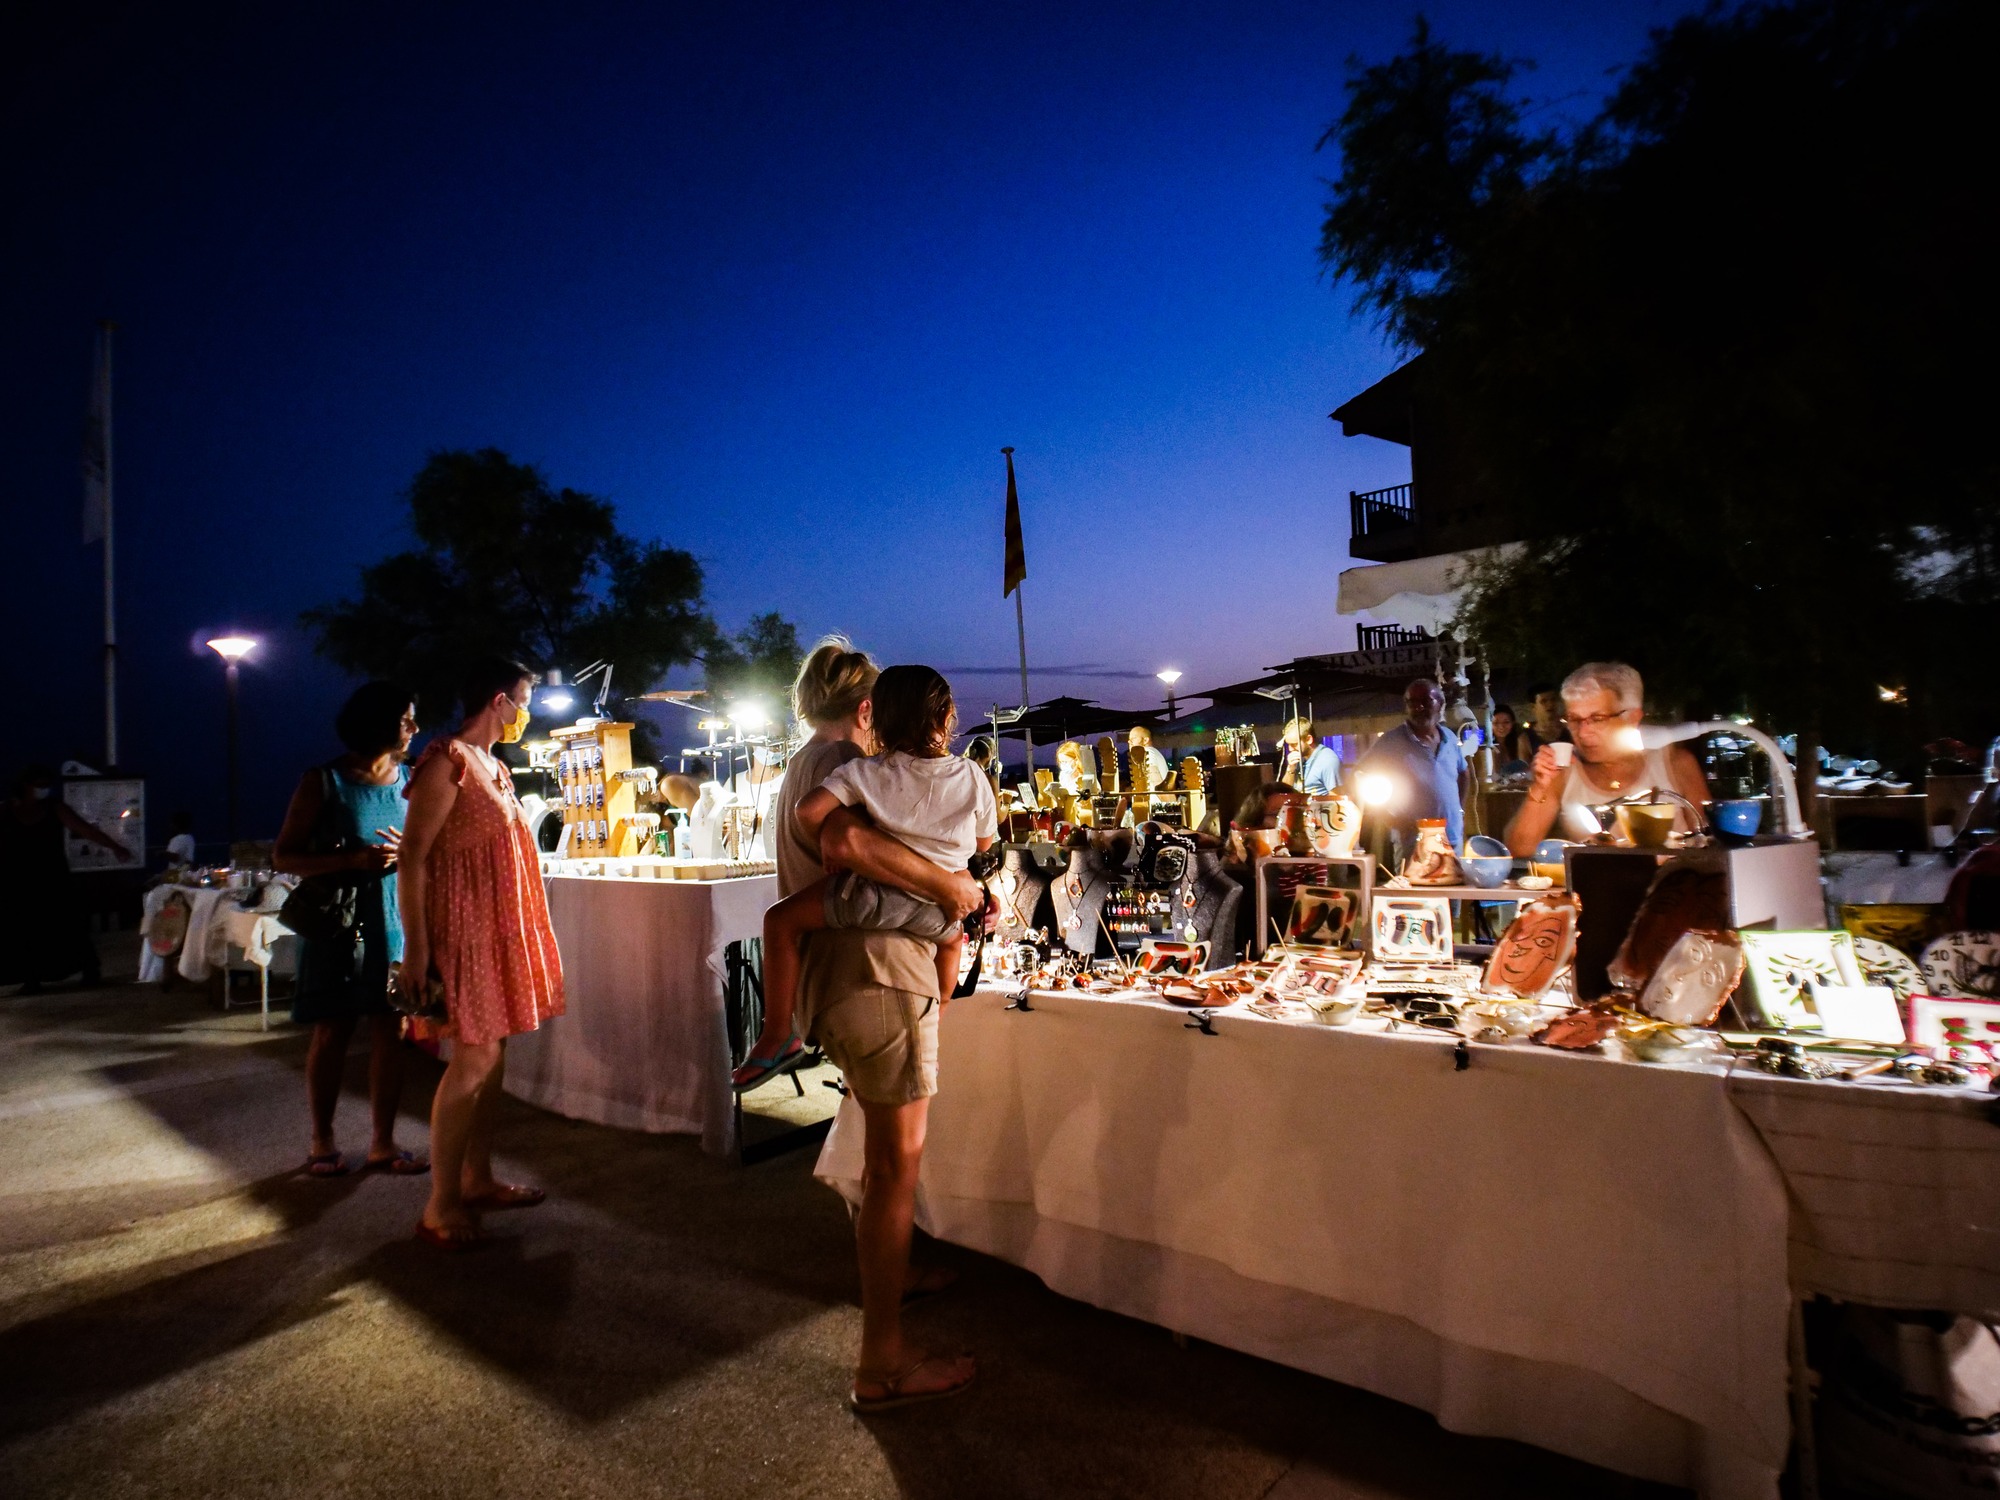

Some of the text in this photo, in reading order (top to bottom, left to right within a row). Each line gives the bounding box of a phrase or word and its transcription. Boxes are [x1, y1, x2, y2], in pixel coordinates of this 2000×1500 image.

[1877, 944, 1887, 956] 1
[1929, 949, 1950, 962] 10
[1899, 958, 1912, 971] 2
[1915, 972, 1927, 986] 3
